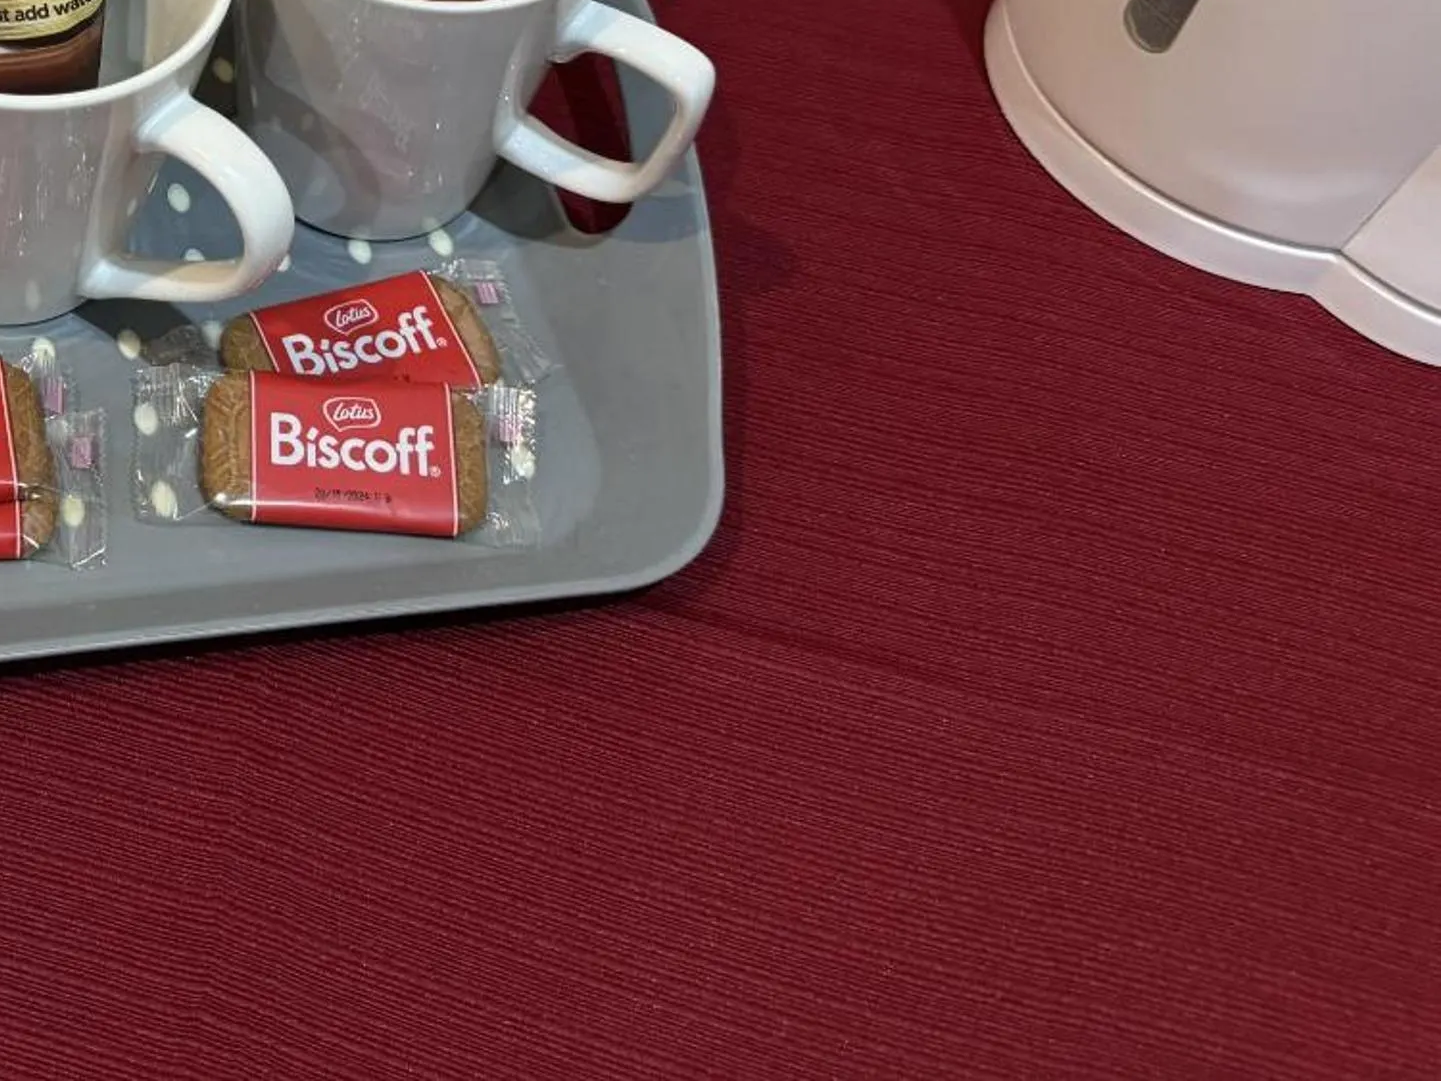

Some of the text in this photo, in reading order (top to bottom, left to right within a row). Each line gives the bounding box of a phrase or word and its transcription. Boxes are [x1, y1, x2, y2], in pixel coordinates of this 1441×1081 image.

[15, 3, 50, 21] add
[334, 306, 373, 328] Lotus
[281, 306, 435, 376] Biscoff
[333, 402, 375, 422] Lotus
[270, 411, 435, 477] Biscoff
